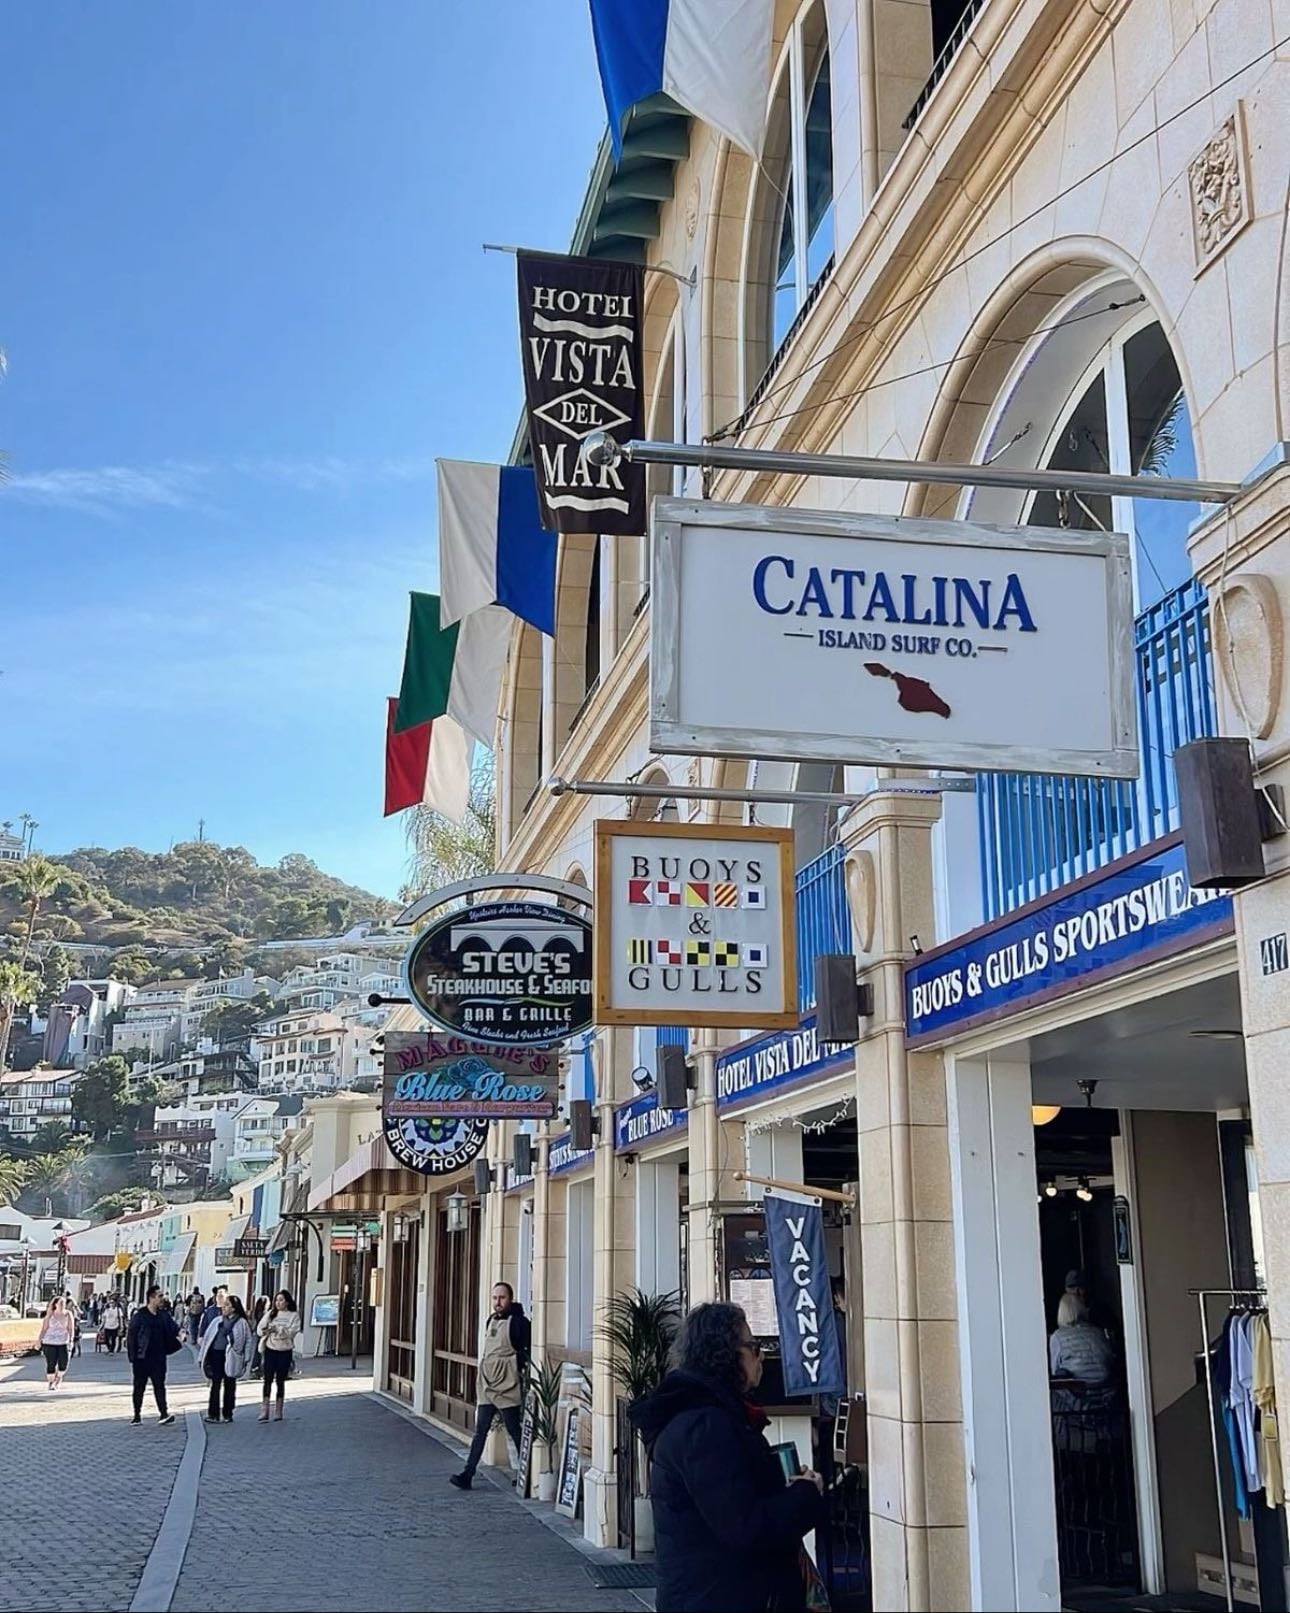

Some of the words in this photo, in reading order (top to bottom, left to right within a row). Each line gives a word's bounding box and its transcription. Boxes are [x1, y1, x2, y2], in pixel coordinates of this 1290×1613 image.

[532, 286, 635, 319] HOTEL
[528, 336, 636, 389] VISTA
[560, 402, 603, 425] DEL
[753, 555, 1038, 632] CATALINA
[818, 629, 886, 652] ISLAND
[891, 634, 940, 655] SURF
[945, 637, 977, 658] CO.
[631, 855, 762, 883] BUOYS
[688, 912, 711, 935] &
[462, 952, 571, 974] STEVE'S
[1262, 936, 1289, 974] 417
[427, 974, 524, 995] STEAKHOUSE
[528, 974, 541, 995] &
[628, 967, 762, 994] GULLS
[912, 971, 963, 1019] BUOYS
[967, 962, 982, 997] &
[986, 931, 1047, 989] GULLS
[464, 1008, 494, 1021] BAR
[502, 1008, 512, 1021] &
[520, 1008, 572, 1021] GRILLE
[504, 1030, 519, 1040] and
[717, 1057, 753, 1099] HOTEL
[755, 1040, 790, 1084] VISTA
[793, 1027, 820, 1070] DEL
[395, 1072, 466, 1101] Blue
[472, 1072, 547, 1101] Rose
[628, 1112, 648, 1142] BLUE
[387, 1128, 428, 1168] BREW
[432, 1132, 484, 1171] HOUSE
[786, 1217, 821, 1383] VACANCY
